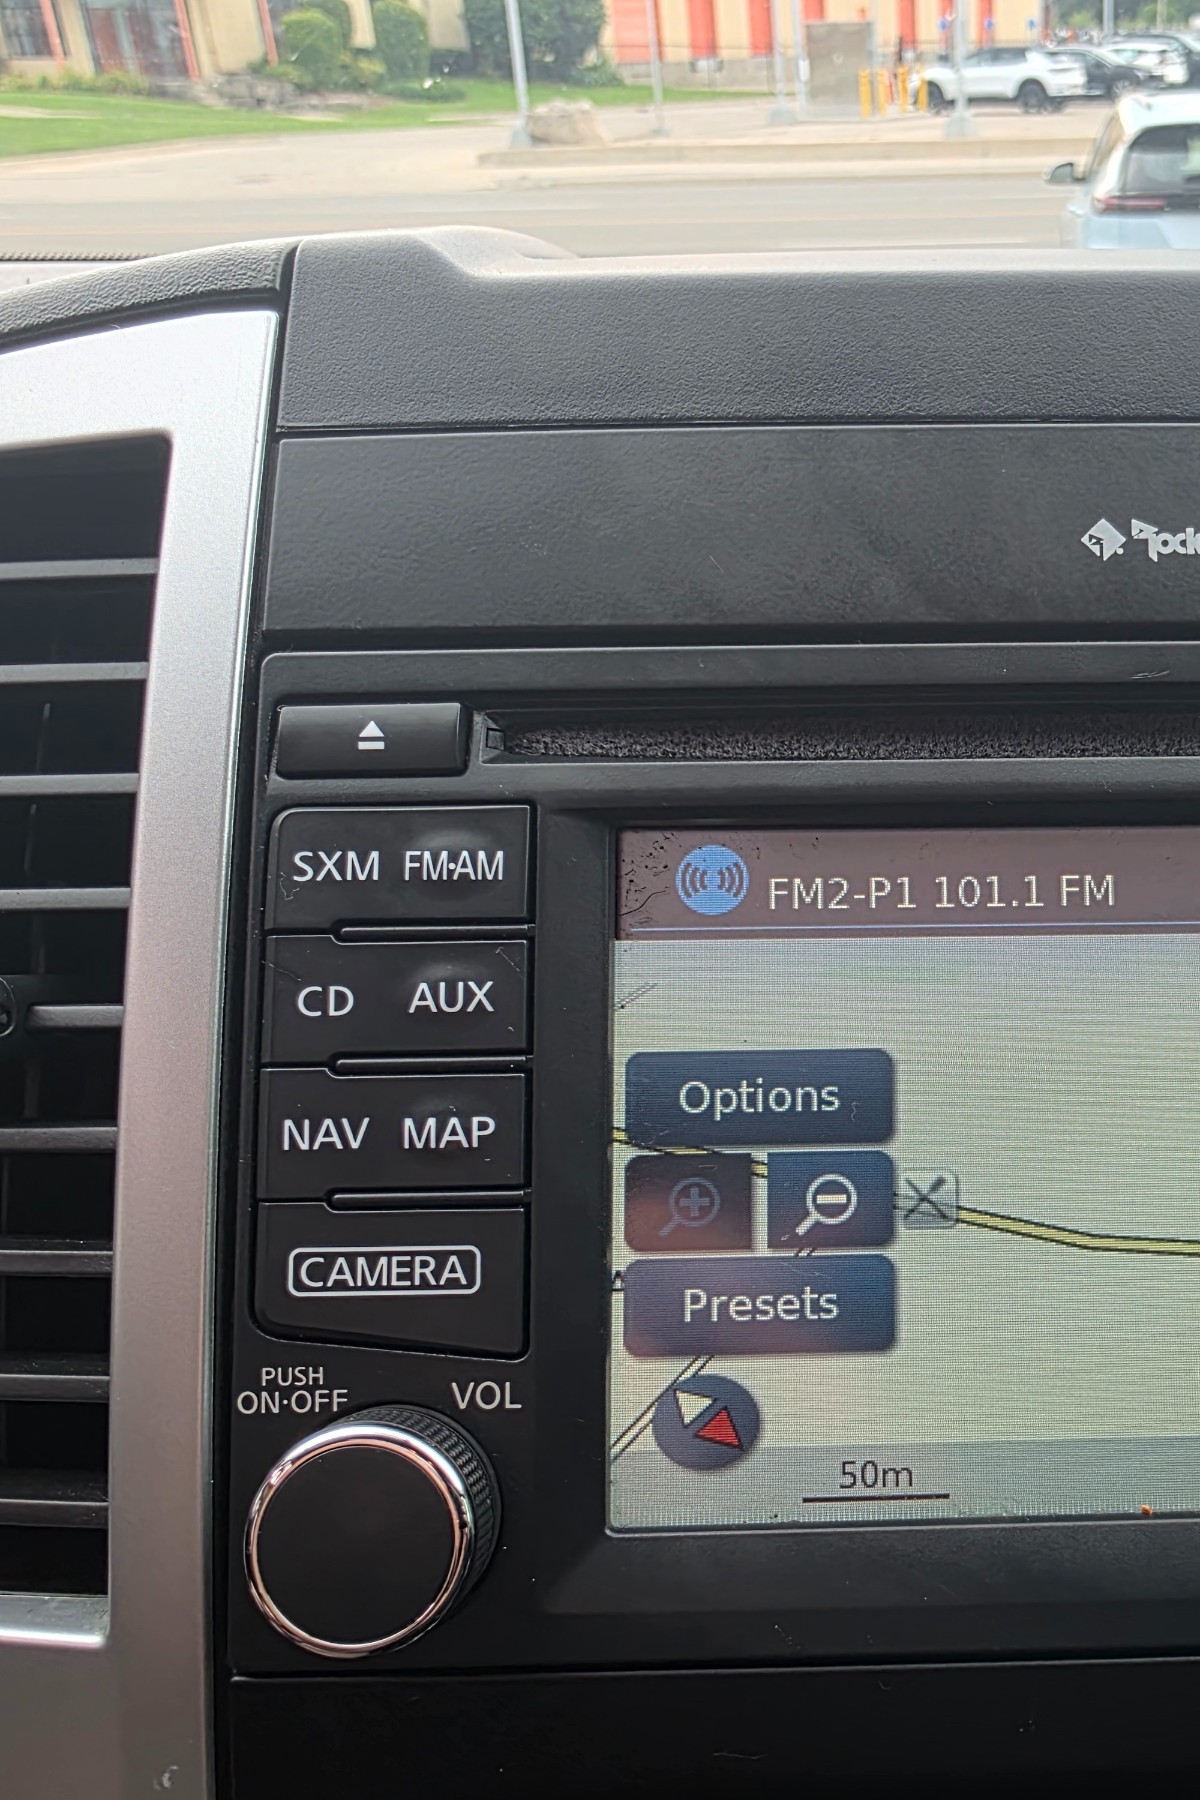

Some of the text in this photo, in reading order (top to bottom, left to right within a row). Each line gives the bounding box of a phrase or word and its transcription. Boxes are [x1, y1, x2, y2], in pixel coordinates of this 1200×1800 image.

[293, 850, 380, 881] SXM
[768, 874, 1116, 910] FM2-P1 101.1 FM
[298, 985, 354, 1016] CD
[408, 980, 495, 1013] AUX
[678, 1077, 841, 1121] Options
[283, 1117, 370, 1150] NAV
[404, 1116, 496, 1149] MAP
[300, 1254, 468, 1287] CAMERA
[683, 1286, 840, 1322] Presets
[261, 1366, 324, 1387] PUSH
[452, 1381, 522, 1410] VOL
[839, 1460, 914, 1489] 50m
